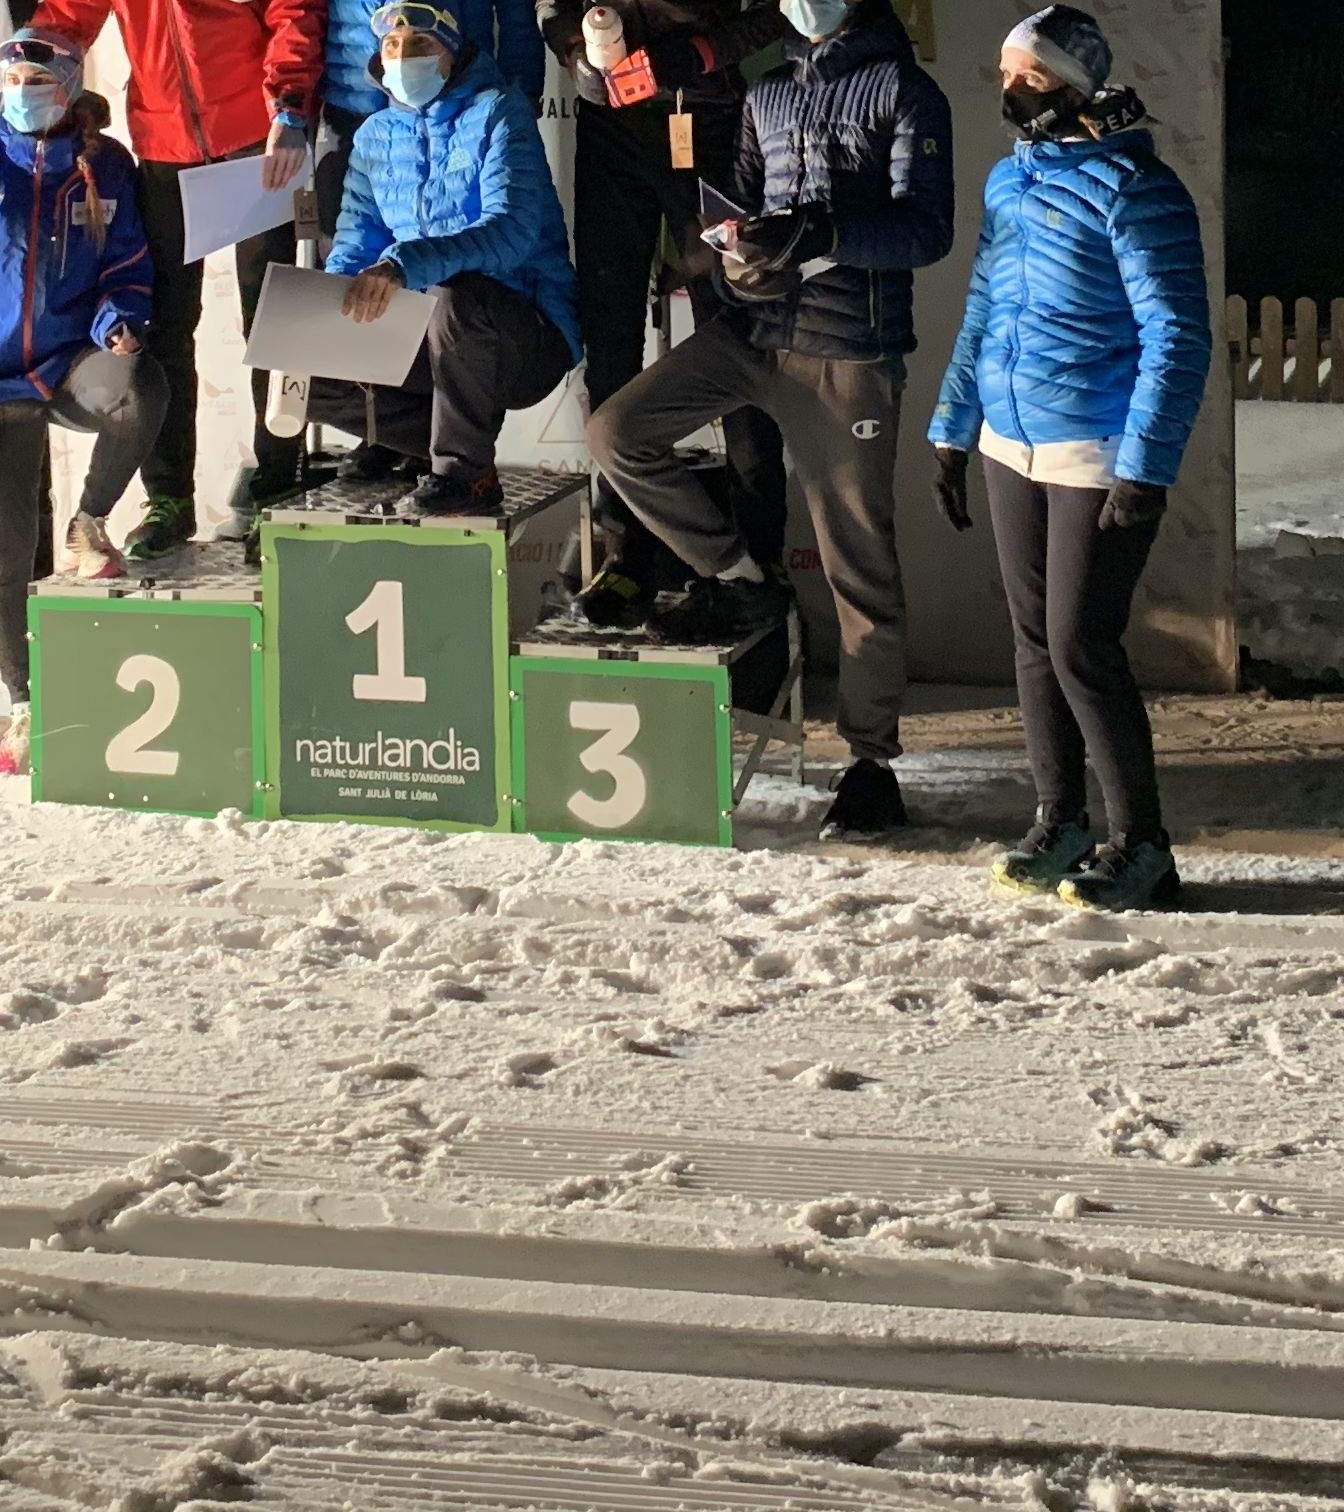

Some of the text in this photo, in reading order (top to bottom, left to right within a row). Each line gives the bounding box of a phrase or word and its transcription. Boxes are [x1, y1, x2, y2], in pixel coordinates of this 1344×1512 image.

[344, 580, 427, 703] 1
[105, 654, 181, 776] 2
[295, 727, 481, 772] naturlandia
[310, 767, 466, 785] EL PARC D'AVENTURES D'ANDORRA
[338, 787, 362, 797] SANT
[395, 790, 407, 800] DE
[567, 700, 647, 828] 3
